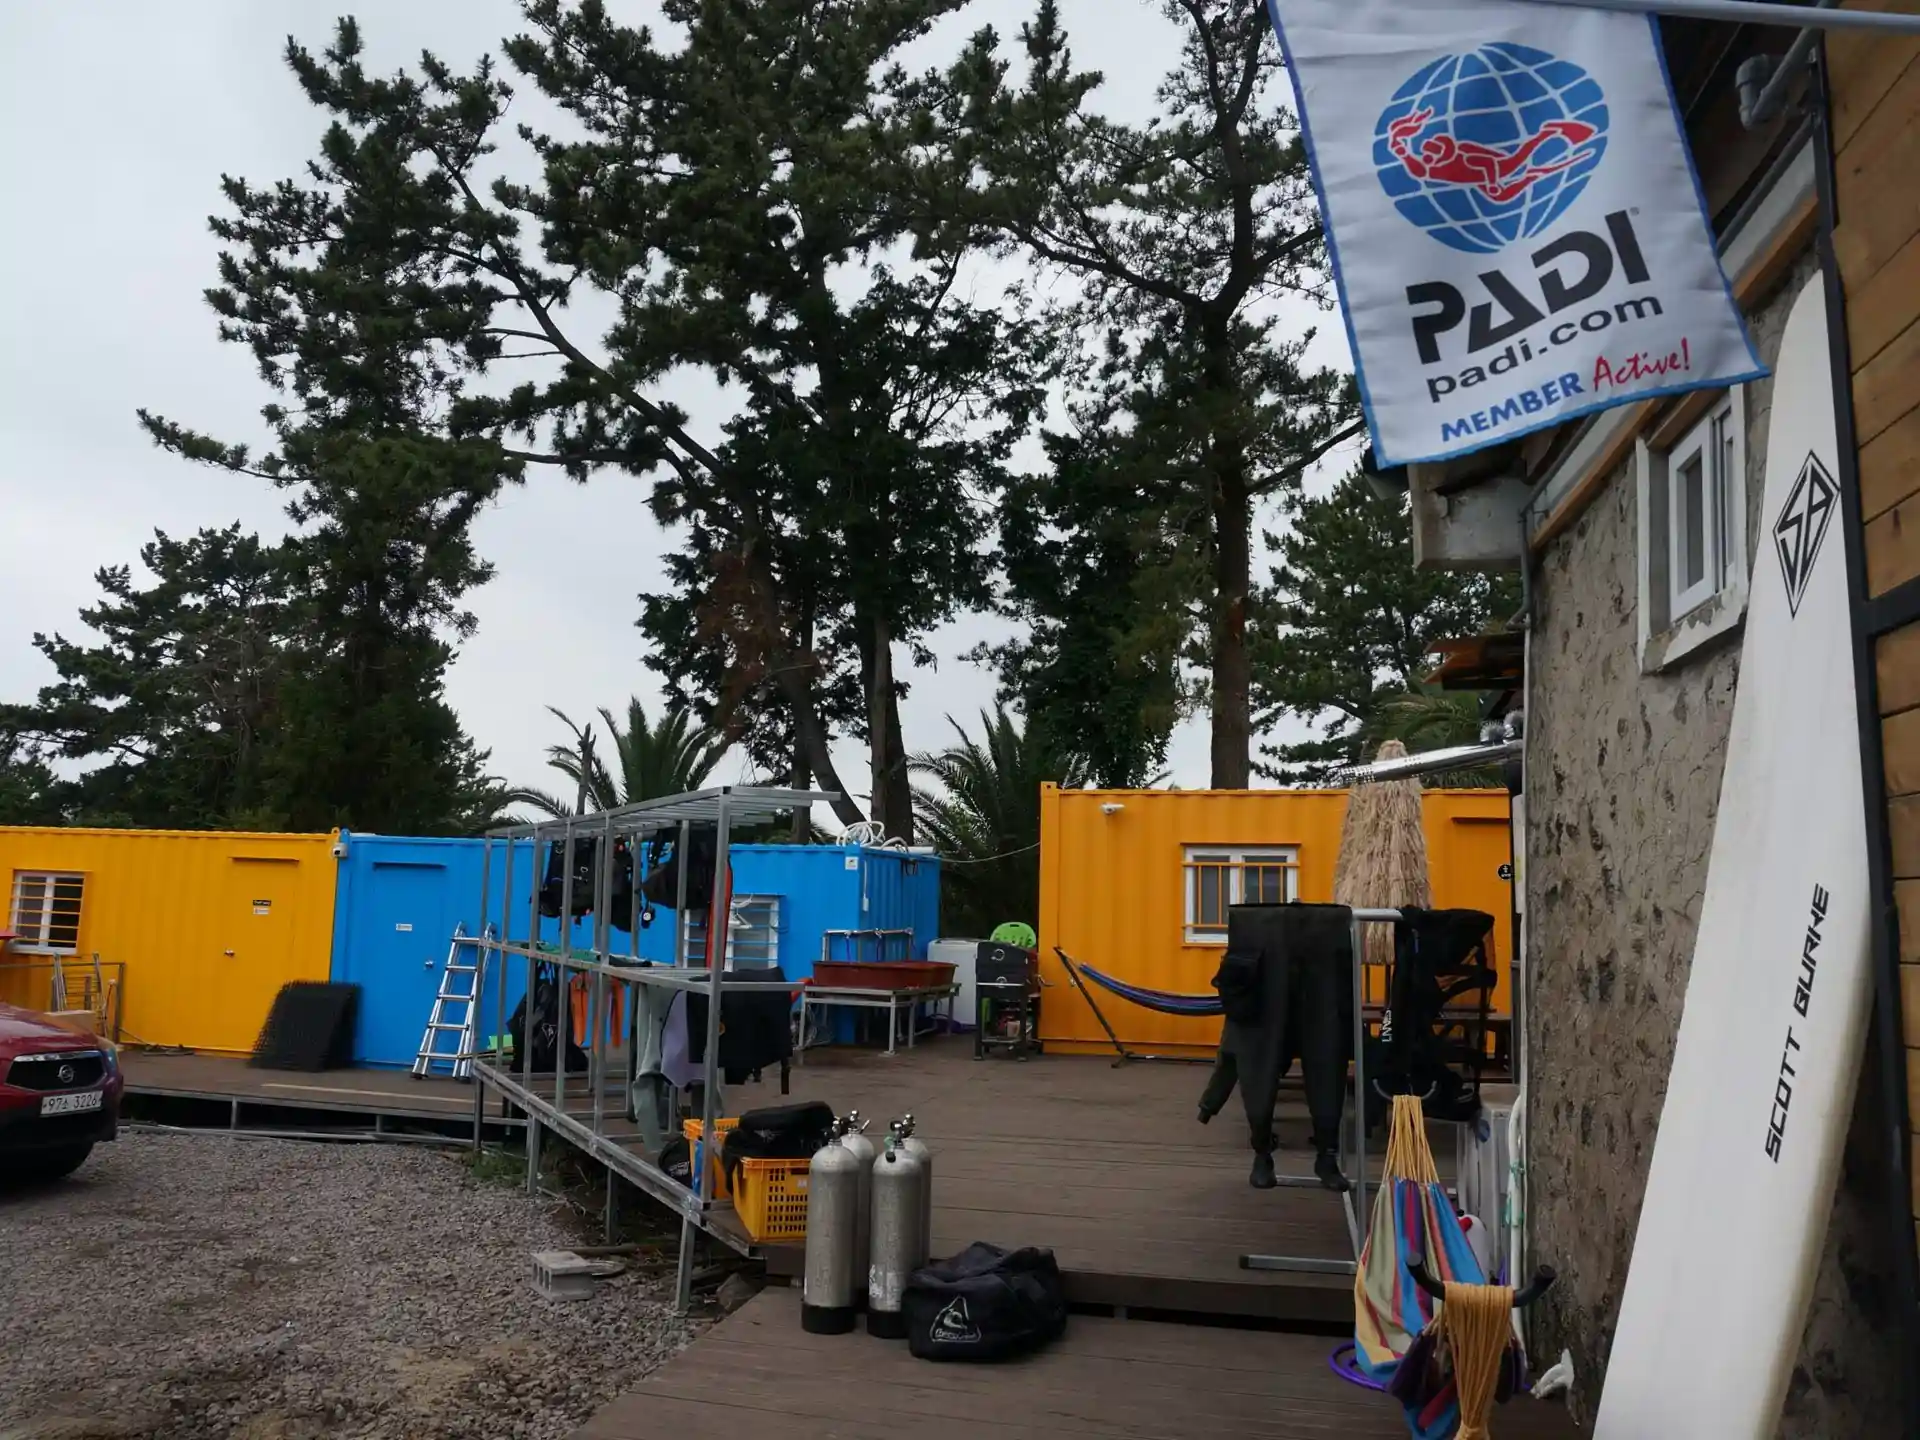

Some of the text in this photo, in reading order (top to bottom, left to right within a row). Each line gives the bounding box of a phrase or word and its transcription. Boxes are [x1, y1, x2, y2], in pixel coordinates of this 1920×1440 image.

[1406, 210, 1650, 365] PADI
[1426, 296, 1664, 403] padi.com
[1441, 337, 1691, 441] MEMBER Active!
[1764, 883, 1829, 1164] SCOTT BURKE
[74, 1094, 97, 1109] 3226
